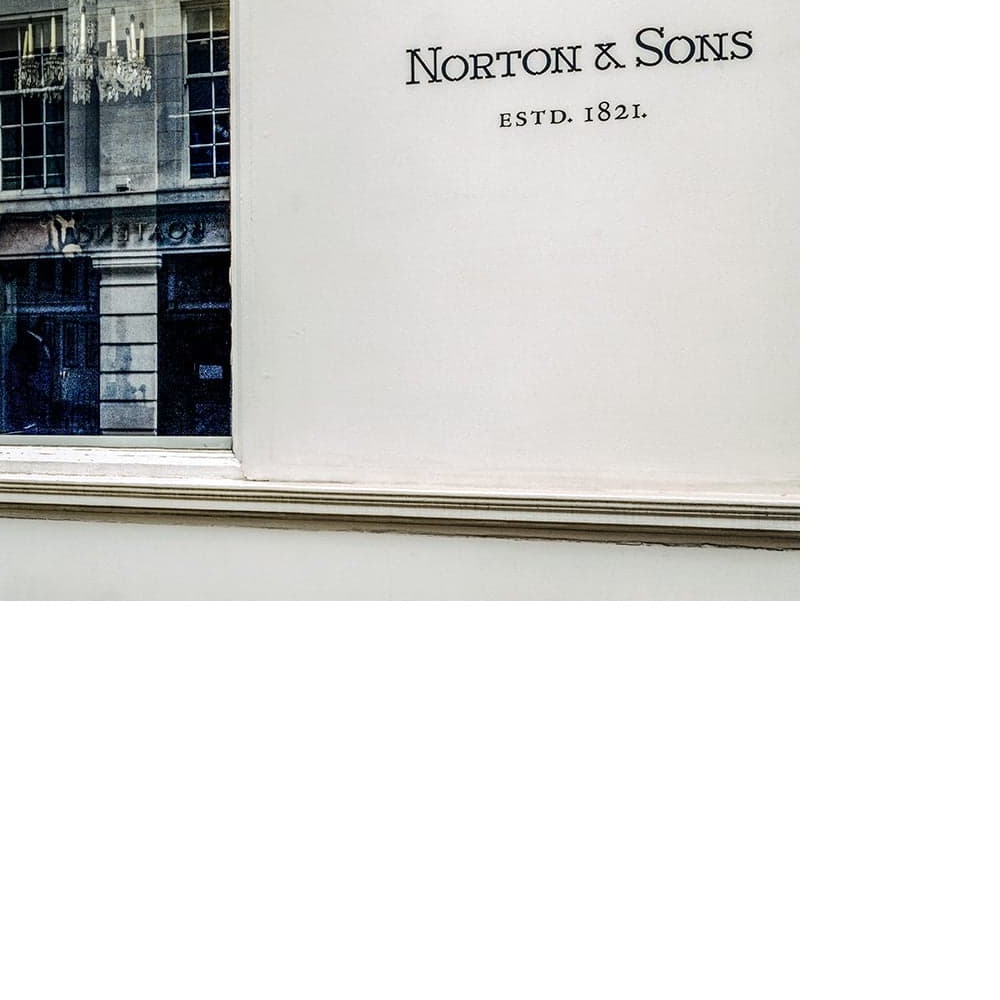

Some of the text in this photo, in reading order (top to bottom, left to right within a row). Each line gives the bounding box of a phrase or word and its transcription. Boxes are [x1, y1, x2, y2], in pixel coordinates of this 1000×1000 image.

[405, 26, 753, 85] NORTON & SONS
[499, 101, 648, 128] ESTD. 1821.
